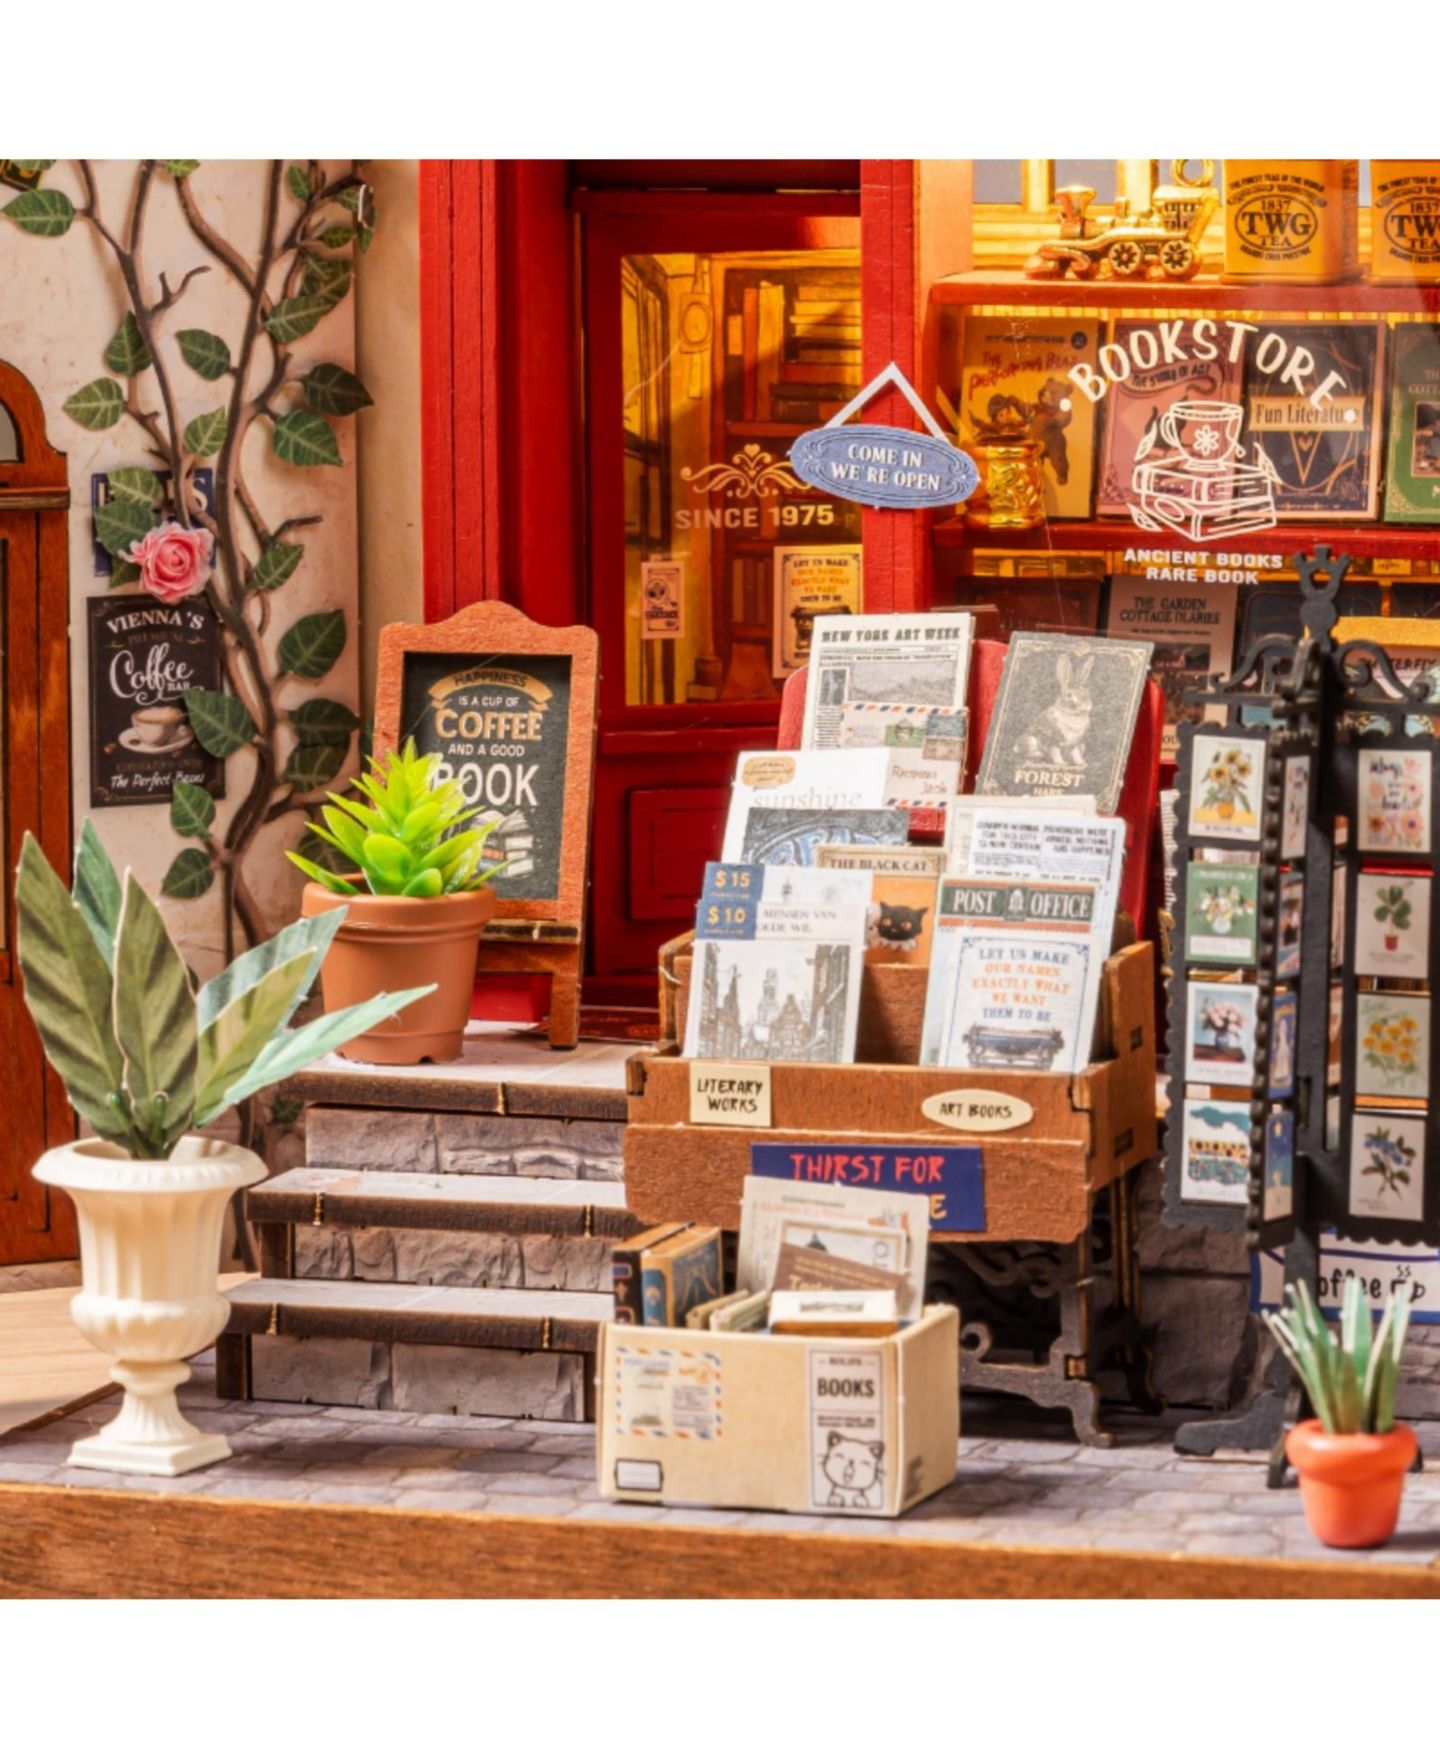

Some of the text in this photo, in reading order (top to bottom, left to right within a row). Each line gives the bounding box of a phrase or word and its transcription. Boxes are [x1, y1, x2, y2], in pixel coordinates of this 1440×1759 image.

[1261, 199, 1291, 213] 1837
[1241, 211, 1311, 236] TWG
[1259, 235, 1292, 247] TEA
[1067, 319, 1348, 412] BOOKSTORE
[1256, 403, 1283, 424] Fun
[848, 443, 924, 468] COME IN
[894, 470, 943, 492] OPEN
[675, 504, 834, 529] SINCE 1975
[1124, 547, 1283, 569] ANCIENT BOOKS
[1146, 567, 1259, 585] RARE BOOK
[1134, 597, 1207, 610] THE GARDEN
[1119, 610, 1172, 624] COTTAGE
[821, 628, 960, 643] NEW YORK ART WEEK
[109, 642, 195, 706] Coffee
[454, 670, 528, 689] HAPPINESS
[458, 695, 520, 707] IS A CUP OF
[434, 709, 543, 742] COFFEE
[447, 743, 526, 757] AND A GOOD
[131, 771, 171, 791] Perfect
[1013, 768, 1086, 788] FOREST
[831, 858, 929, 872] THE BLACK CAT
[952, 889, 1091, 918] POST OFFICE
[979, 948, 1071, 965] LET US MAKE
[985, 964, 1061, 977] OUR NAMES
[972, 976, 1071, 995] EXACTLY WHAT
[991, 992, 1047, 1006] WE WANT
[982, 1008, 1052, 1021] THEM TO BE
[697, 1078, 763, 1095] LITERARY
[707, 1095, 759, 1114] WORKS
[939, 1102, 1013, 1119] ART BOOKS
[789, 1153, 945, 1184] THIRST FOR
[817, 1375, 875, 1399] BOOKS
